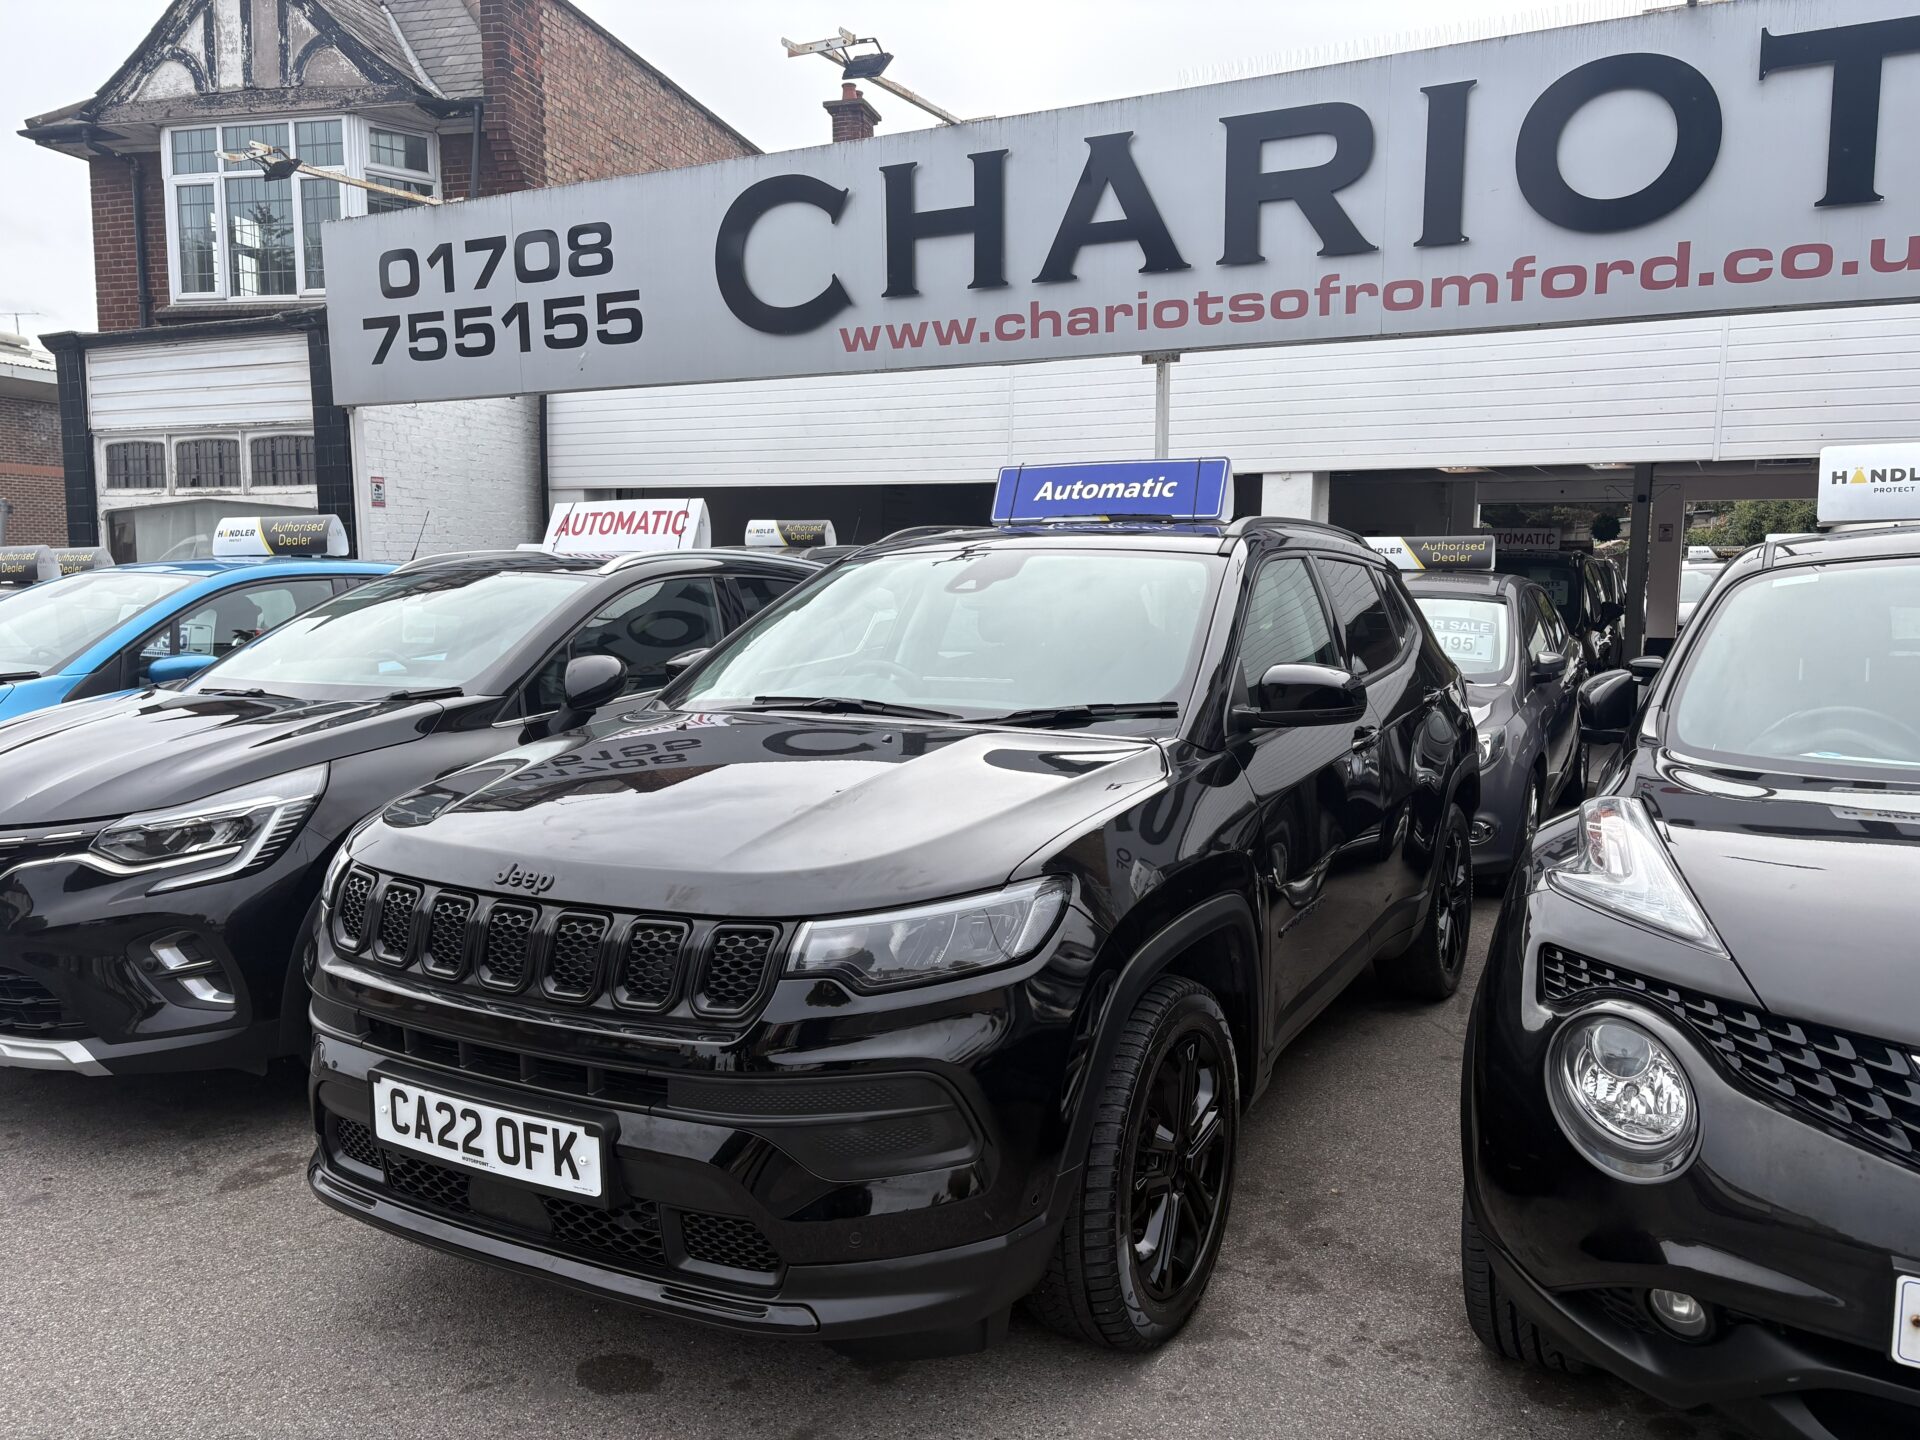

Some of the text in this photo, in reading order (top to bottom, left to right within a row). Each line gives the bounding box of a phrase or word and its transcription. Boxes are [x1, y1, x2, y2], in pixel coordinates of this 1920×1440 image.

[714, 15, 1920, 336] CHARIOT
[378, 221, 614, 300] 01708
[362, 289, 644, 366] 755155
[1033, 475, 1179, 502] Automatic
[1873, 486, 1916, 494] PROTECT
[270, 520, 326, 533] Authorised
[554, 510, 690, 537] AUTOMATIC
[785, 524, 824, 532] Authorised
[278, 534, 312, 546] Dealer
[790, 532, 815, 540] Dealer
[1421, 541, 1486, 551] Authorised
[1432, 552, 1473, 562] Dealer
[1, 563, 26, 573] Dealer
[1449, 621, 1491, 632] SALE
[494, 863, 555, 895] Jeep
[389, 1087, 581, 1181] CA22 OFK
